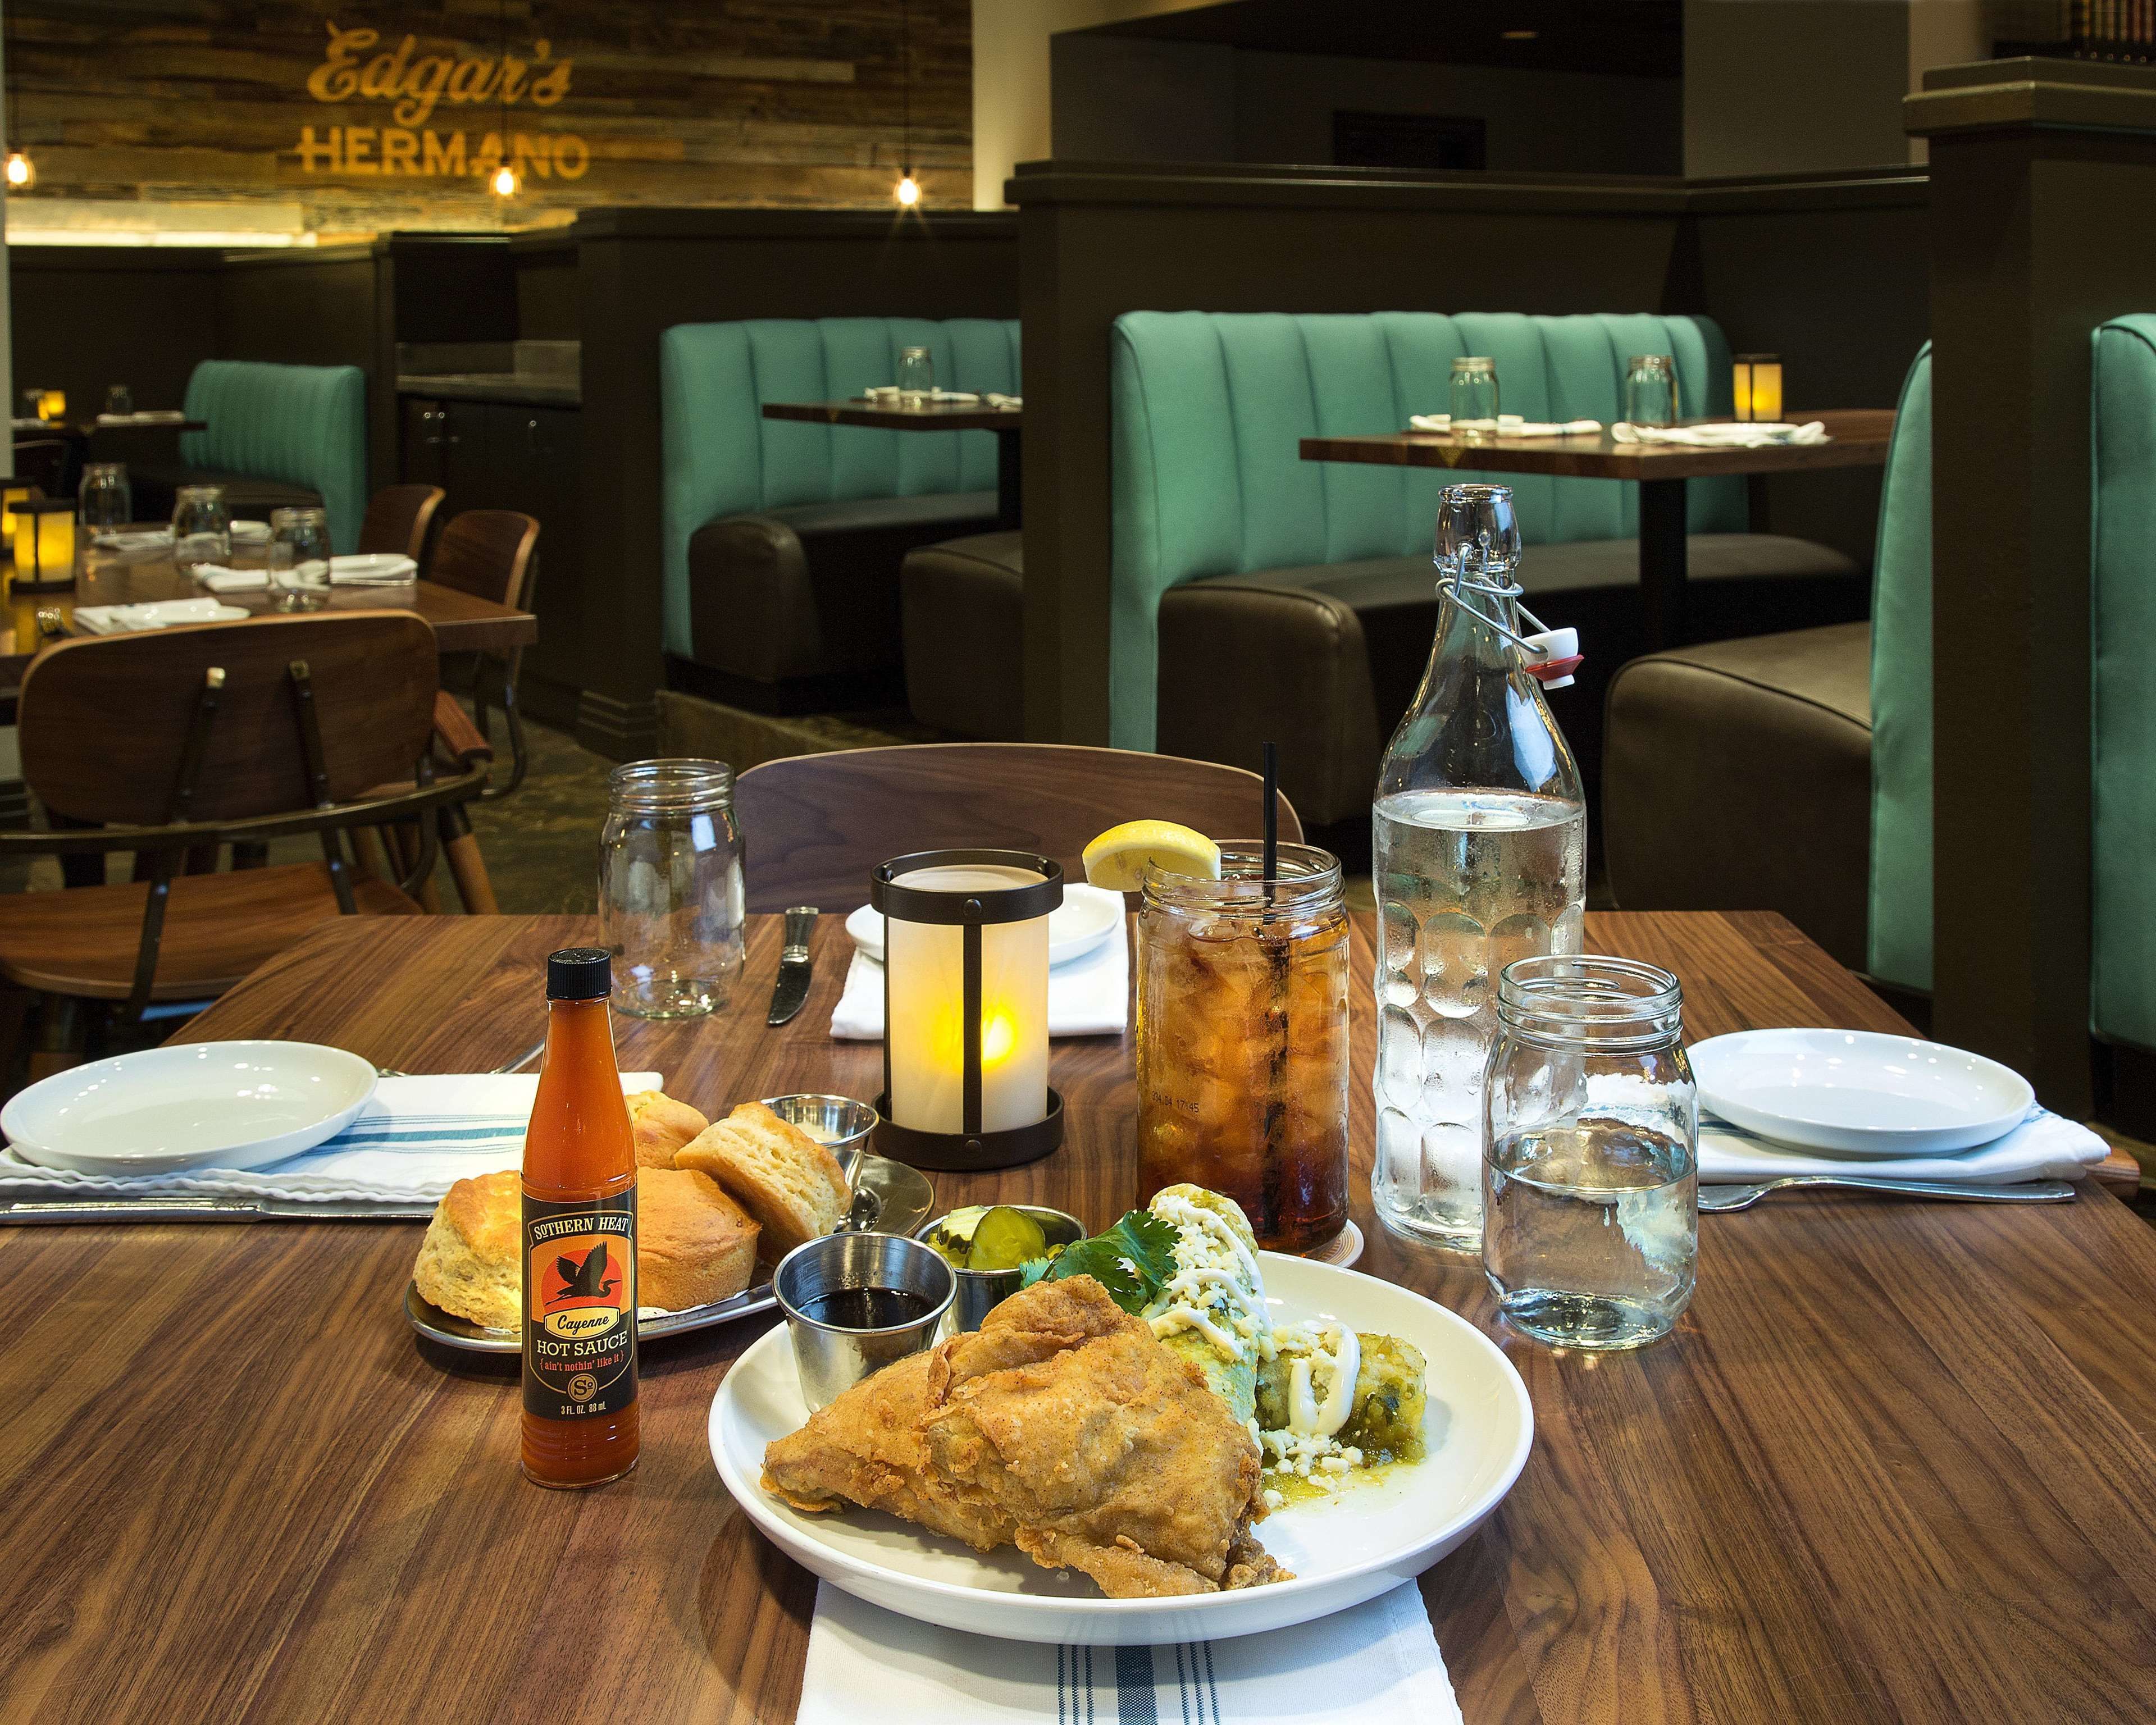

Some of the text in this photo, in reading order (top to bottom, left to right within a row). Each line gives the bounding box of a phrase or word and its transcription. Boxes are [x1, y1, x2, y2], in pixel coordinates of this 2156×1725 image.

[306, 19, 574, 128] Edgar's
[292, 125, 590, 180] HERMANO
[598, 1217, 629, 1231] HEAT
[557, 1315, 609, 1335] Cayenne
[537, 1330, 627, 1356] HOT SAUCE
[564, 1359, 595, 1371] nothin'
[597, 1356, 612, 1368] like
[561, 1401, 607, 1414] 3 FL. OZ. 88 mL
